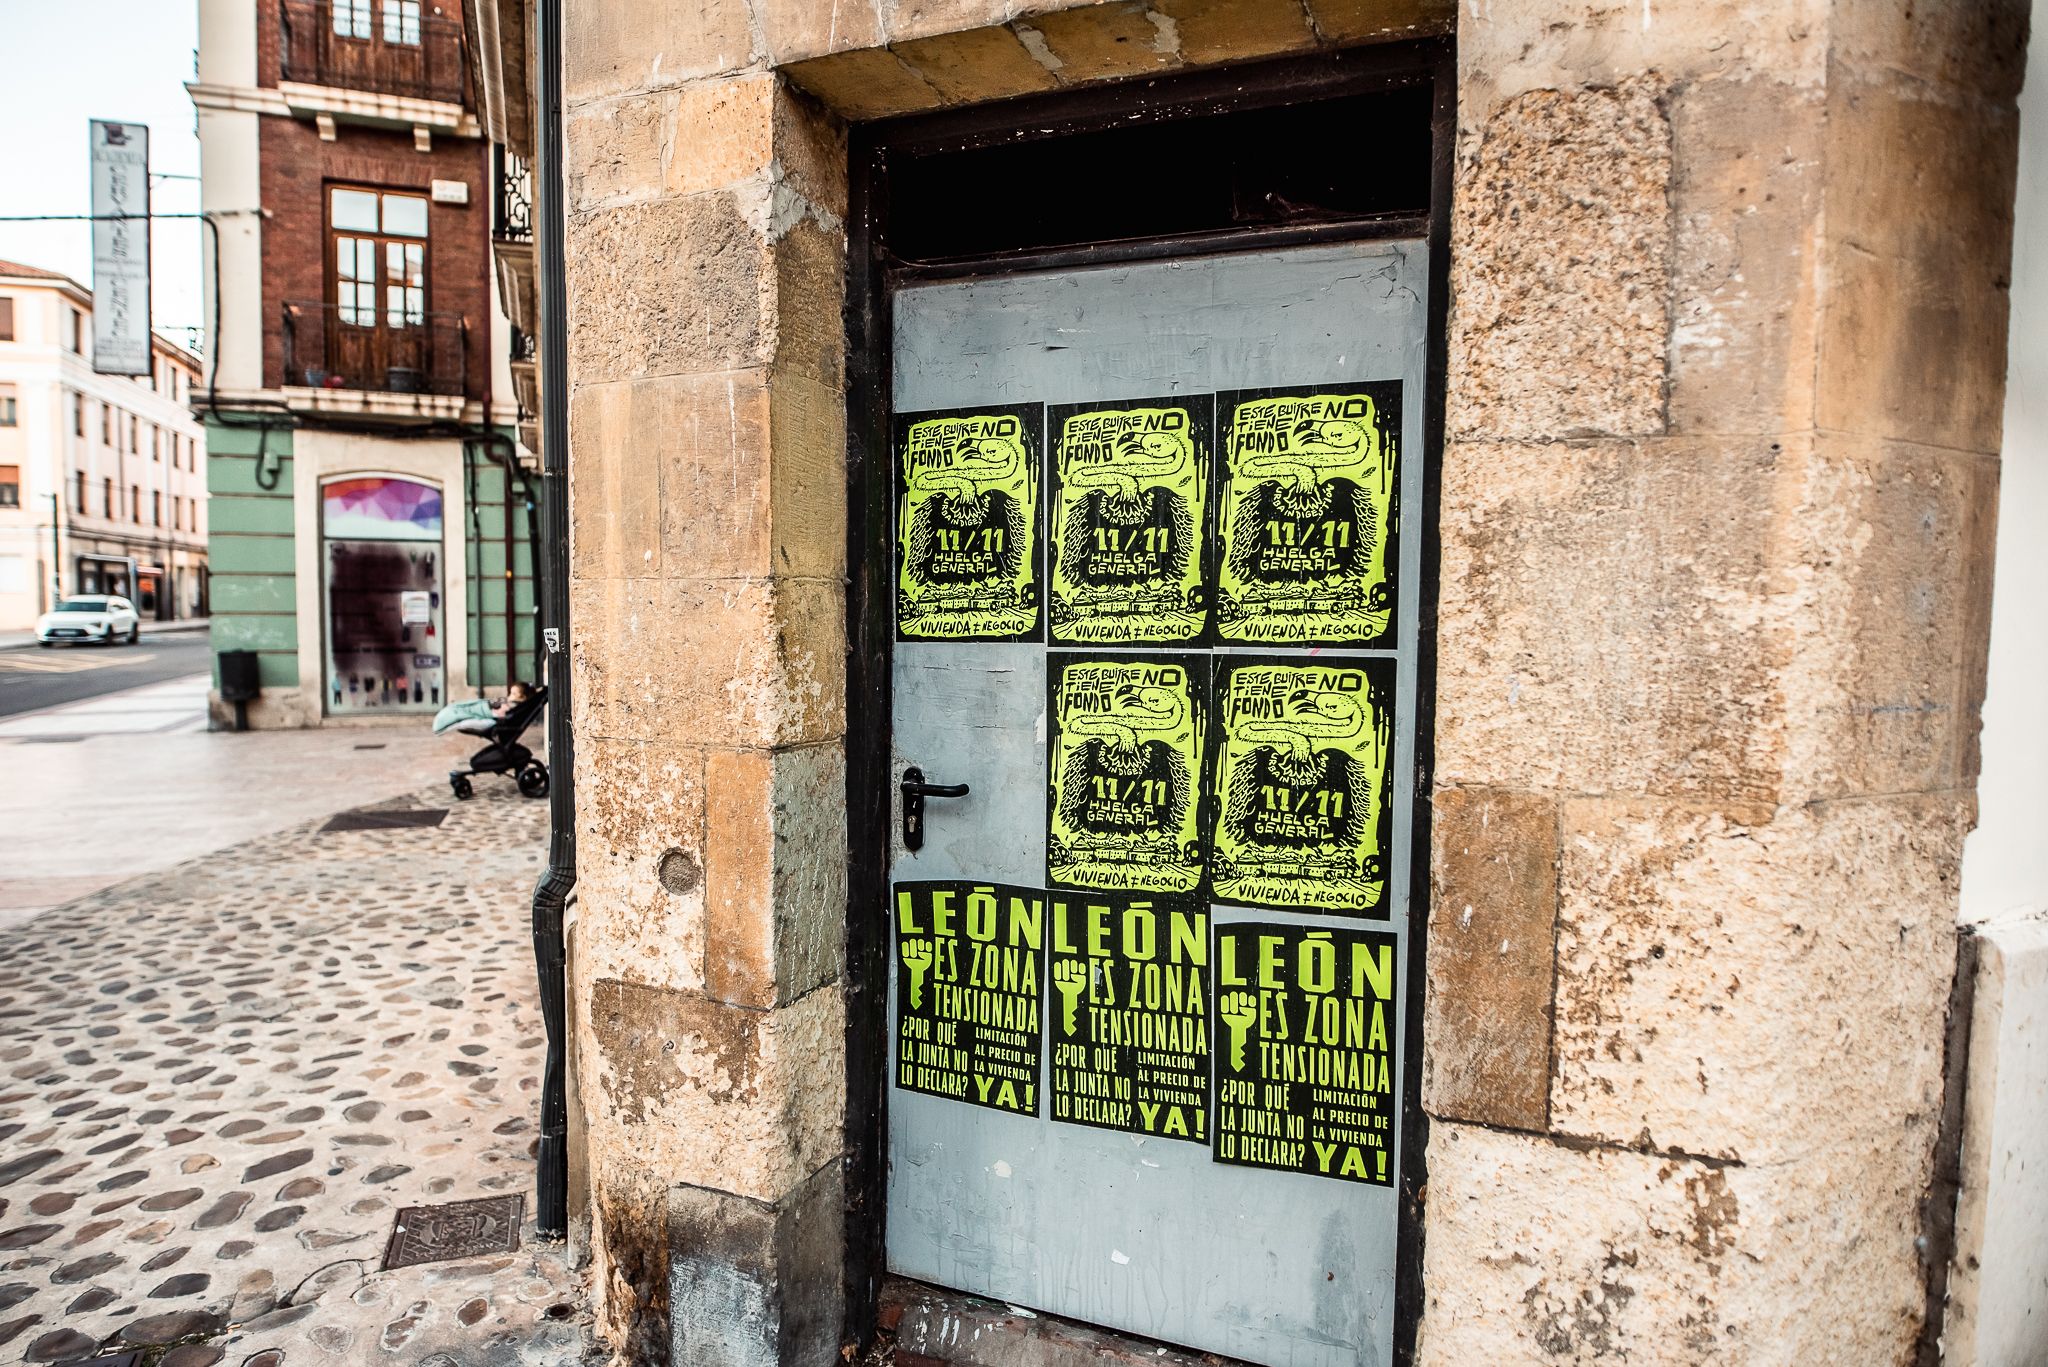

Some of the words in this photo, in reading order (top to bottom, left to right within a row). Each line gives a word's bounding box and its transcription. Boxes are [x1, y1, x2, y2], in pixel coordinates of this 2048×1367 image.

[1240, 404, 1276, 420] ESTE
[1324, 399, 1367, 419] NO
[913, 424, 942, 439] ESTE
[981, 419, 1016, 437] NO
[1069, 417, 1101, 432] ESTE
[1144, 412, 1183, 431] NO
[1064, 443, 1112, 475] FONDO
[1234, 431, 1288, 465] FONDO
[909, 448, 954, 479] FONDO
[935, 552, 993, 562] HUELGA
[1091, 552, 1156, 563] HUELGA
[1263, 547, 1335, 558] HUELGA
[932, 562, 997, 574] GENERAL
[1089, 563, 1160, 575] GENERAL
[1260, 558, 1340, 571] GENERAL
[920, 620, 970, 635] VIVIENDA
[982, 620, 1025, 632] NEGOCIO
[1075, 625, 1131, 639] VIVIENDA
[1144, 625, 1191, 636] NEGOCIO
[1245, 623, 1305, 639] VIVIENDA
[1320, 624, 1373, 637] NEGOCIO
[1068, 668, 1100, 680] ESTE
[1142, 669, 1180, 686] NO
[1236, 672, 1272, 684] ESTE
[1318, 673, 1362, 691] NO
[1063, 692, 1111, 722] FONDO
[1230, 697, 1284, 728] FONDO
[1087, 811, 1158, 825] GENERAL
[1090, 800, 1154, 815] HUELGA
[1258, 811, 1329, 827] HUELGA
[1255, 823, 1334, 839] GENERAL
[1074, 869, 1128, 888] VIVIENDA
[1141, 875, 1187, 889] NEGOCIO
[1239, 884, 1300, 904] VIVIENDA
[1314, 891, 1366, 906] NEGOCIO
[898, 887, 1042, 950] LEÓN
[1054, 902, 1207, 966] LEÓN
[935, 937, 958, 982] ES
[970, 942, 1037, 996] ZONA
[1221, 932, 1392, 1000] LEÓN
[1089, 957, 1115, 1006] ES
[1129, 961, 1204, 1015] ZONA
[934, 983, 1038, 1034] TENSIONADA
[902, 1016, 930, 1040] ¿POR
[937, 1021, 957, 1046] QUÉ
[1089, 1007, 1207, 1055] TENSIONADA
[1259, 990, 1288, 1040] ES
[1304, 994, 1388, 1052] ZONA
[975, 1027, 1027, 1047] LIMITACIÓN
[902, 1040, 914, 1062] LA
[918, 1042, 949, 1069] JUNTA
[954, 1049, 968, 1072] NO
[975, 1044, 985, 1056] AL
[989, 1046, 1020, 1063] PRECIO
[1025, 1052, 1036, 1066] DE
[1055, 1042, 1086, 1069] ¿POR
[1095, 1047, 1117, 1073] QUÉ
[1138, 1051, 1196, 1070] LIMITACIÓN
[975, 1060, 984, 1072] LA
[988, 1063, 1031, 1081] VIVIENDA
[1259, 1041, 1390, 1094] TENSIONADA
[902, 1063, 913, 1086] LO
[918, 1066, 968, 1097] DECLARA?
[1055, 1068, 1069, 1092] LA
[1074, 1070, 1110, 1098] JUNTA
[1115, 1076, 1131, 1100] NO
[1138, 1069, 1149, 1082] AL
[1153, 1070, 1189, 1087] PRECIO
[1193, 1075, 1206, 1089] DE
[974, 1074, 1034, 1112] YA!
[1138, 1086, 1149, 1099] LA
[1153, 1088, 1201, 1107] VIVIENDA
[1221, 1078, 1255, 1106] ¿POR
[1265, 1083, 1290, 1111] QUÉ
[1313, 1088, 1376, 1109] LIMITACIÓN
[1056, 1094, 1069, 1117] LO
[1075, 1097, 1132, 1127] DECLARA?
[1138, 1101, 1205, 1140] YA!
[1313, 1107, 1325, 1121] AL
[1330, 1109, 1368, 1127] PRECIO
[1375, 1115, 1388, 1130] DE
[1221, 1106, 1235, 1131] LA
[1241, 1108, 1281, 1137] JUNTA
[1287, 1114, 1304, 1140] NO
[1313, 1126, 1325, 1140] LA
[1330, 1128, 1383, 1148] VIVIENDA
[1220, 1133, 1235, 1159] LO
[1241, 1136, 1305, 1167] DECLARA?
[1312, 1141, 1387, 1181] YA!
